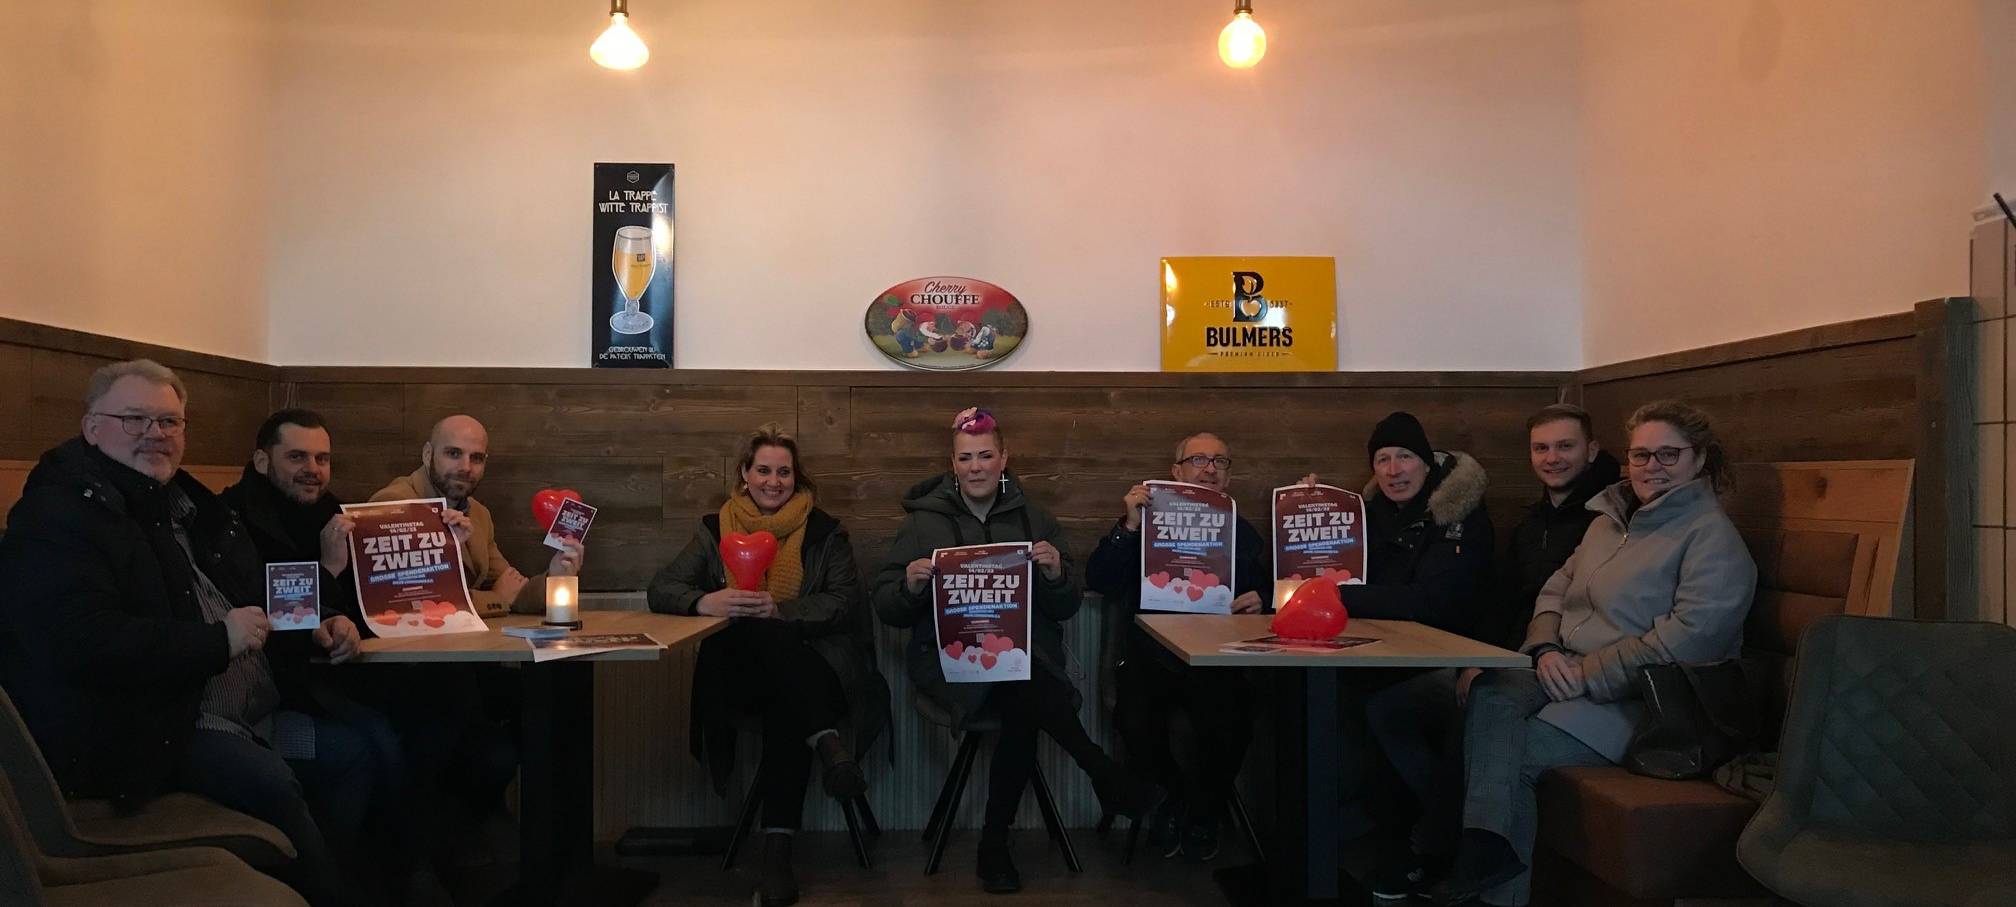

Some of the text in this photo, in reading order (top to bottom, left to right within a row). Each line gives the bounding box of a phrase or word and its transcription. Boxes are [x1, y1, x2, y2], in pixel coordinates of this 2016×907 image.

[609, 190, 657, 200] LA TRAPPE
[599, 202, 668, 213] WITTE TRAPPIST
[924, 281, 966, 297] Cherry
[910, 294, 980, 304] CHOUFFE
[1206, 327, 1293, 347] BULMERS
[1152, 512, 1225, 527] ZEIT ZU
[1283, 512, 1355, 528] ZEIT ZU
[1157, 526, 1220, 541] ZWEIT
[1288, 525, 1351, 542] ZWEIT
[363, 531, 446, 554] ZEIT ZU
[371, 548, 444, 571] ZWEIT
[943, 575, 1020, 589] ZEIT ZU
[948, 590, 1015, 604] ZWEIT
